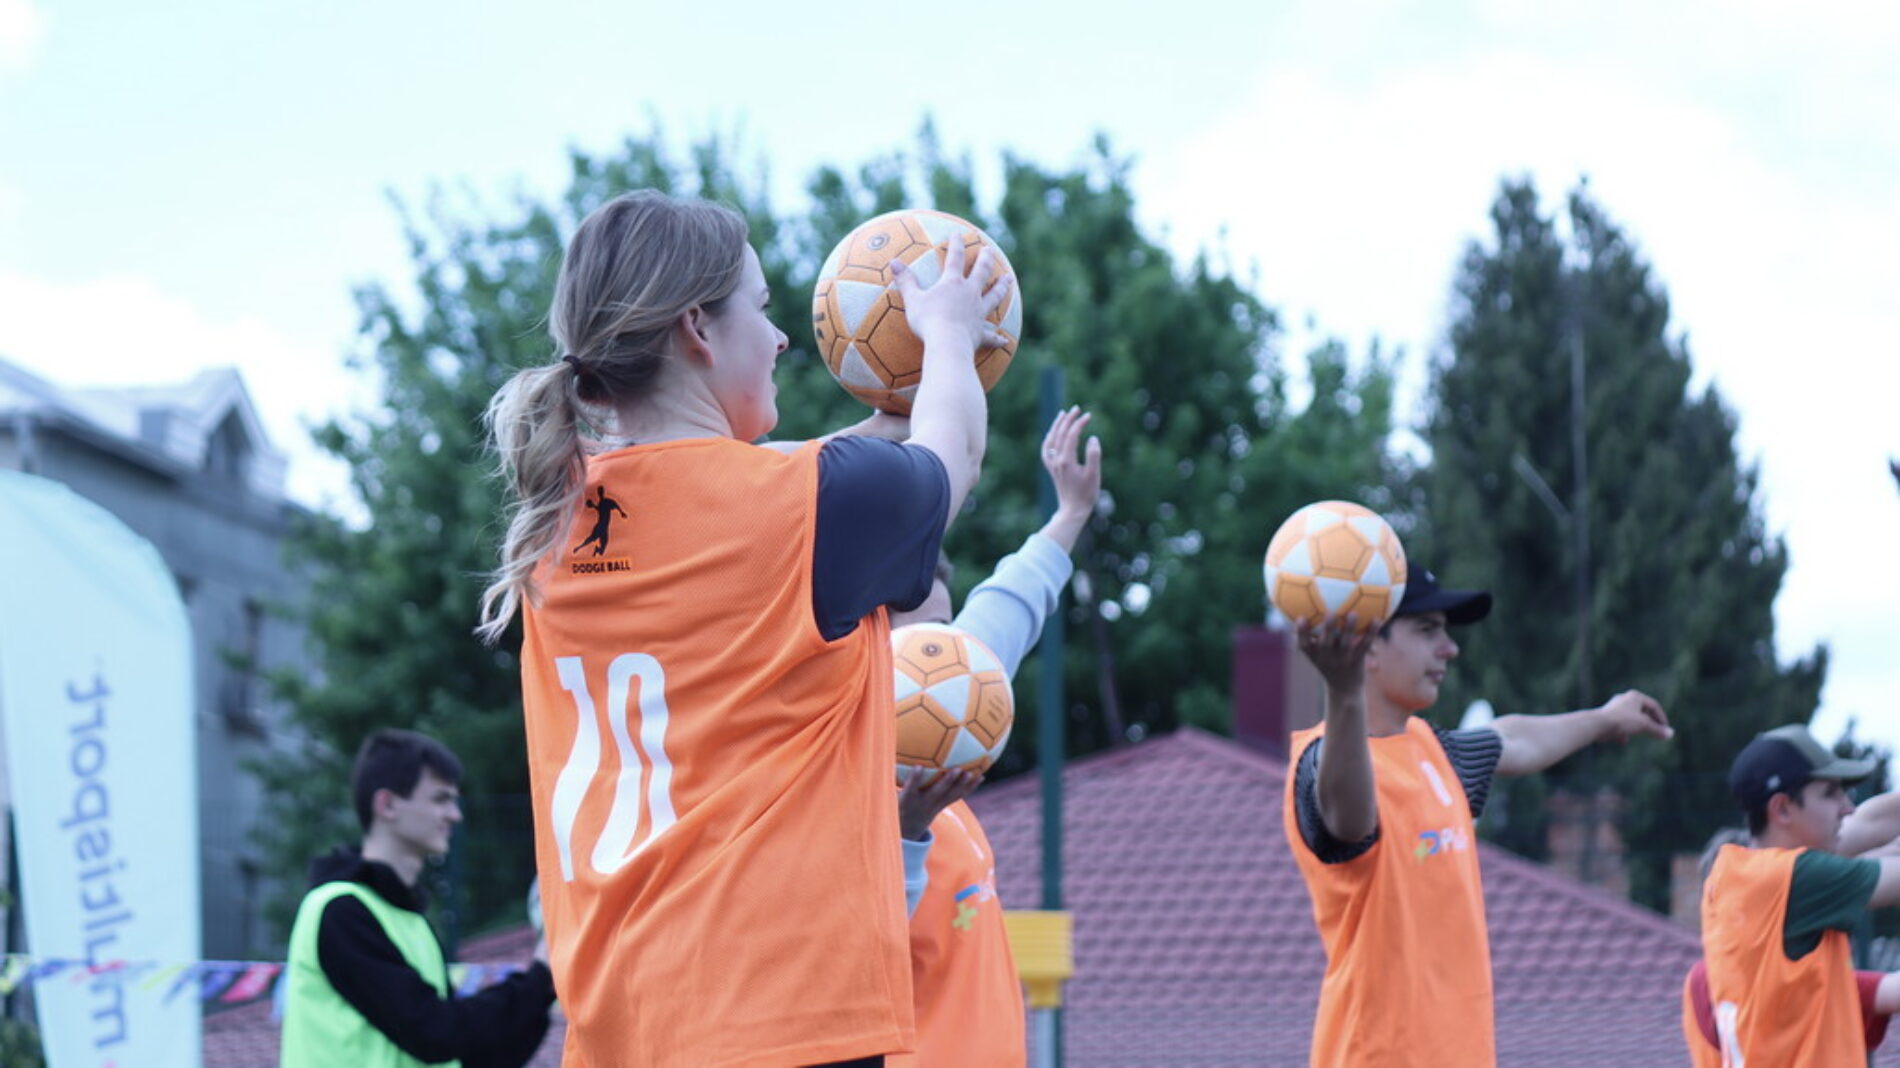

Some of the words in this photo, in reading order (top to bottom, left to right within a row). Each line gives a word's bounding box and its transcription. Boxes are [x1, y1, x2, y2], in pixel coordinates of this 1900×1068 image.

[572, 562, 605, 573] DODGE
[607, 560, 630, 572] BALL
[551, 652, 678, 882] 10
